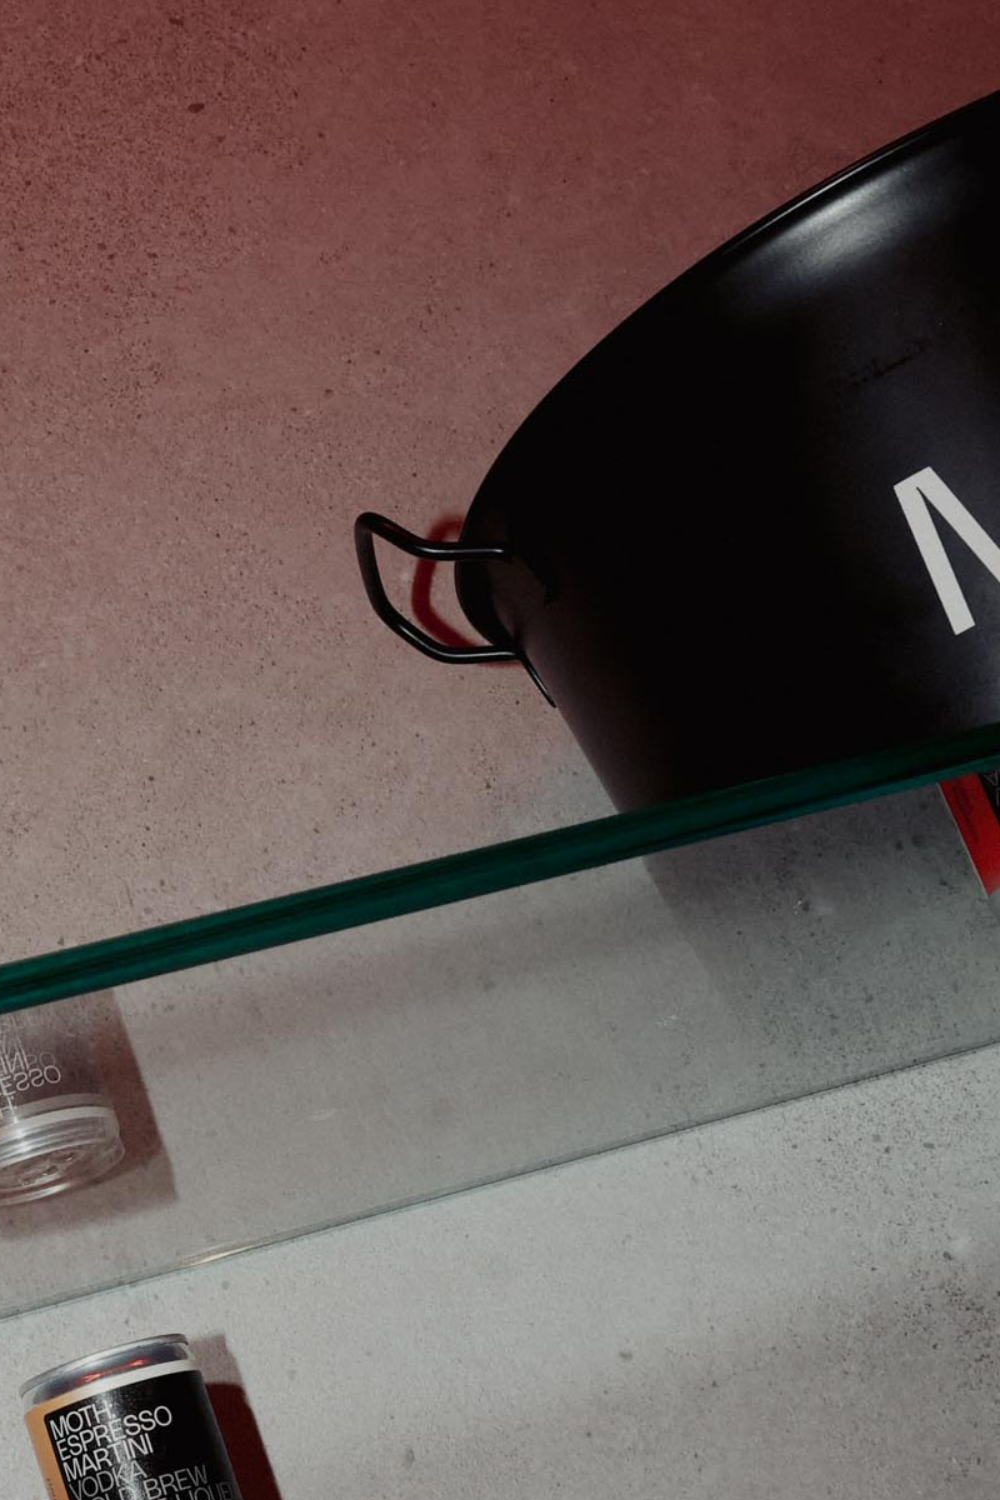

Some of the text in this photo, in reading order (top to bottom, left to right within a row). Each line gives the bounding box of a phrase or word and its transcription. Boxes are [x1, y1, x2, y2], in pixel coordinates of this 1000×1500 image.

[50, 1403, 116, 1440] MOTH:
[56, 1406, 172, 1460] ESPRESSO
[63, 1433, 154, 1482] MARTINI
[144, 1465, 208, 1500] BREW
